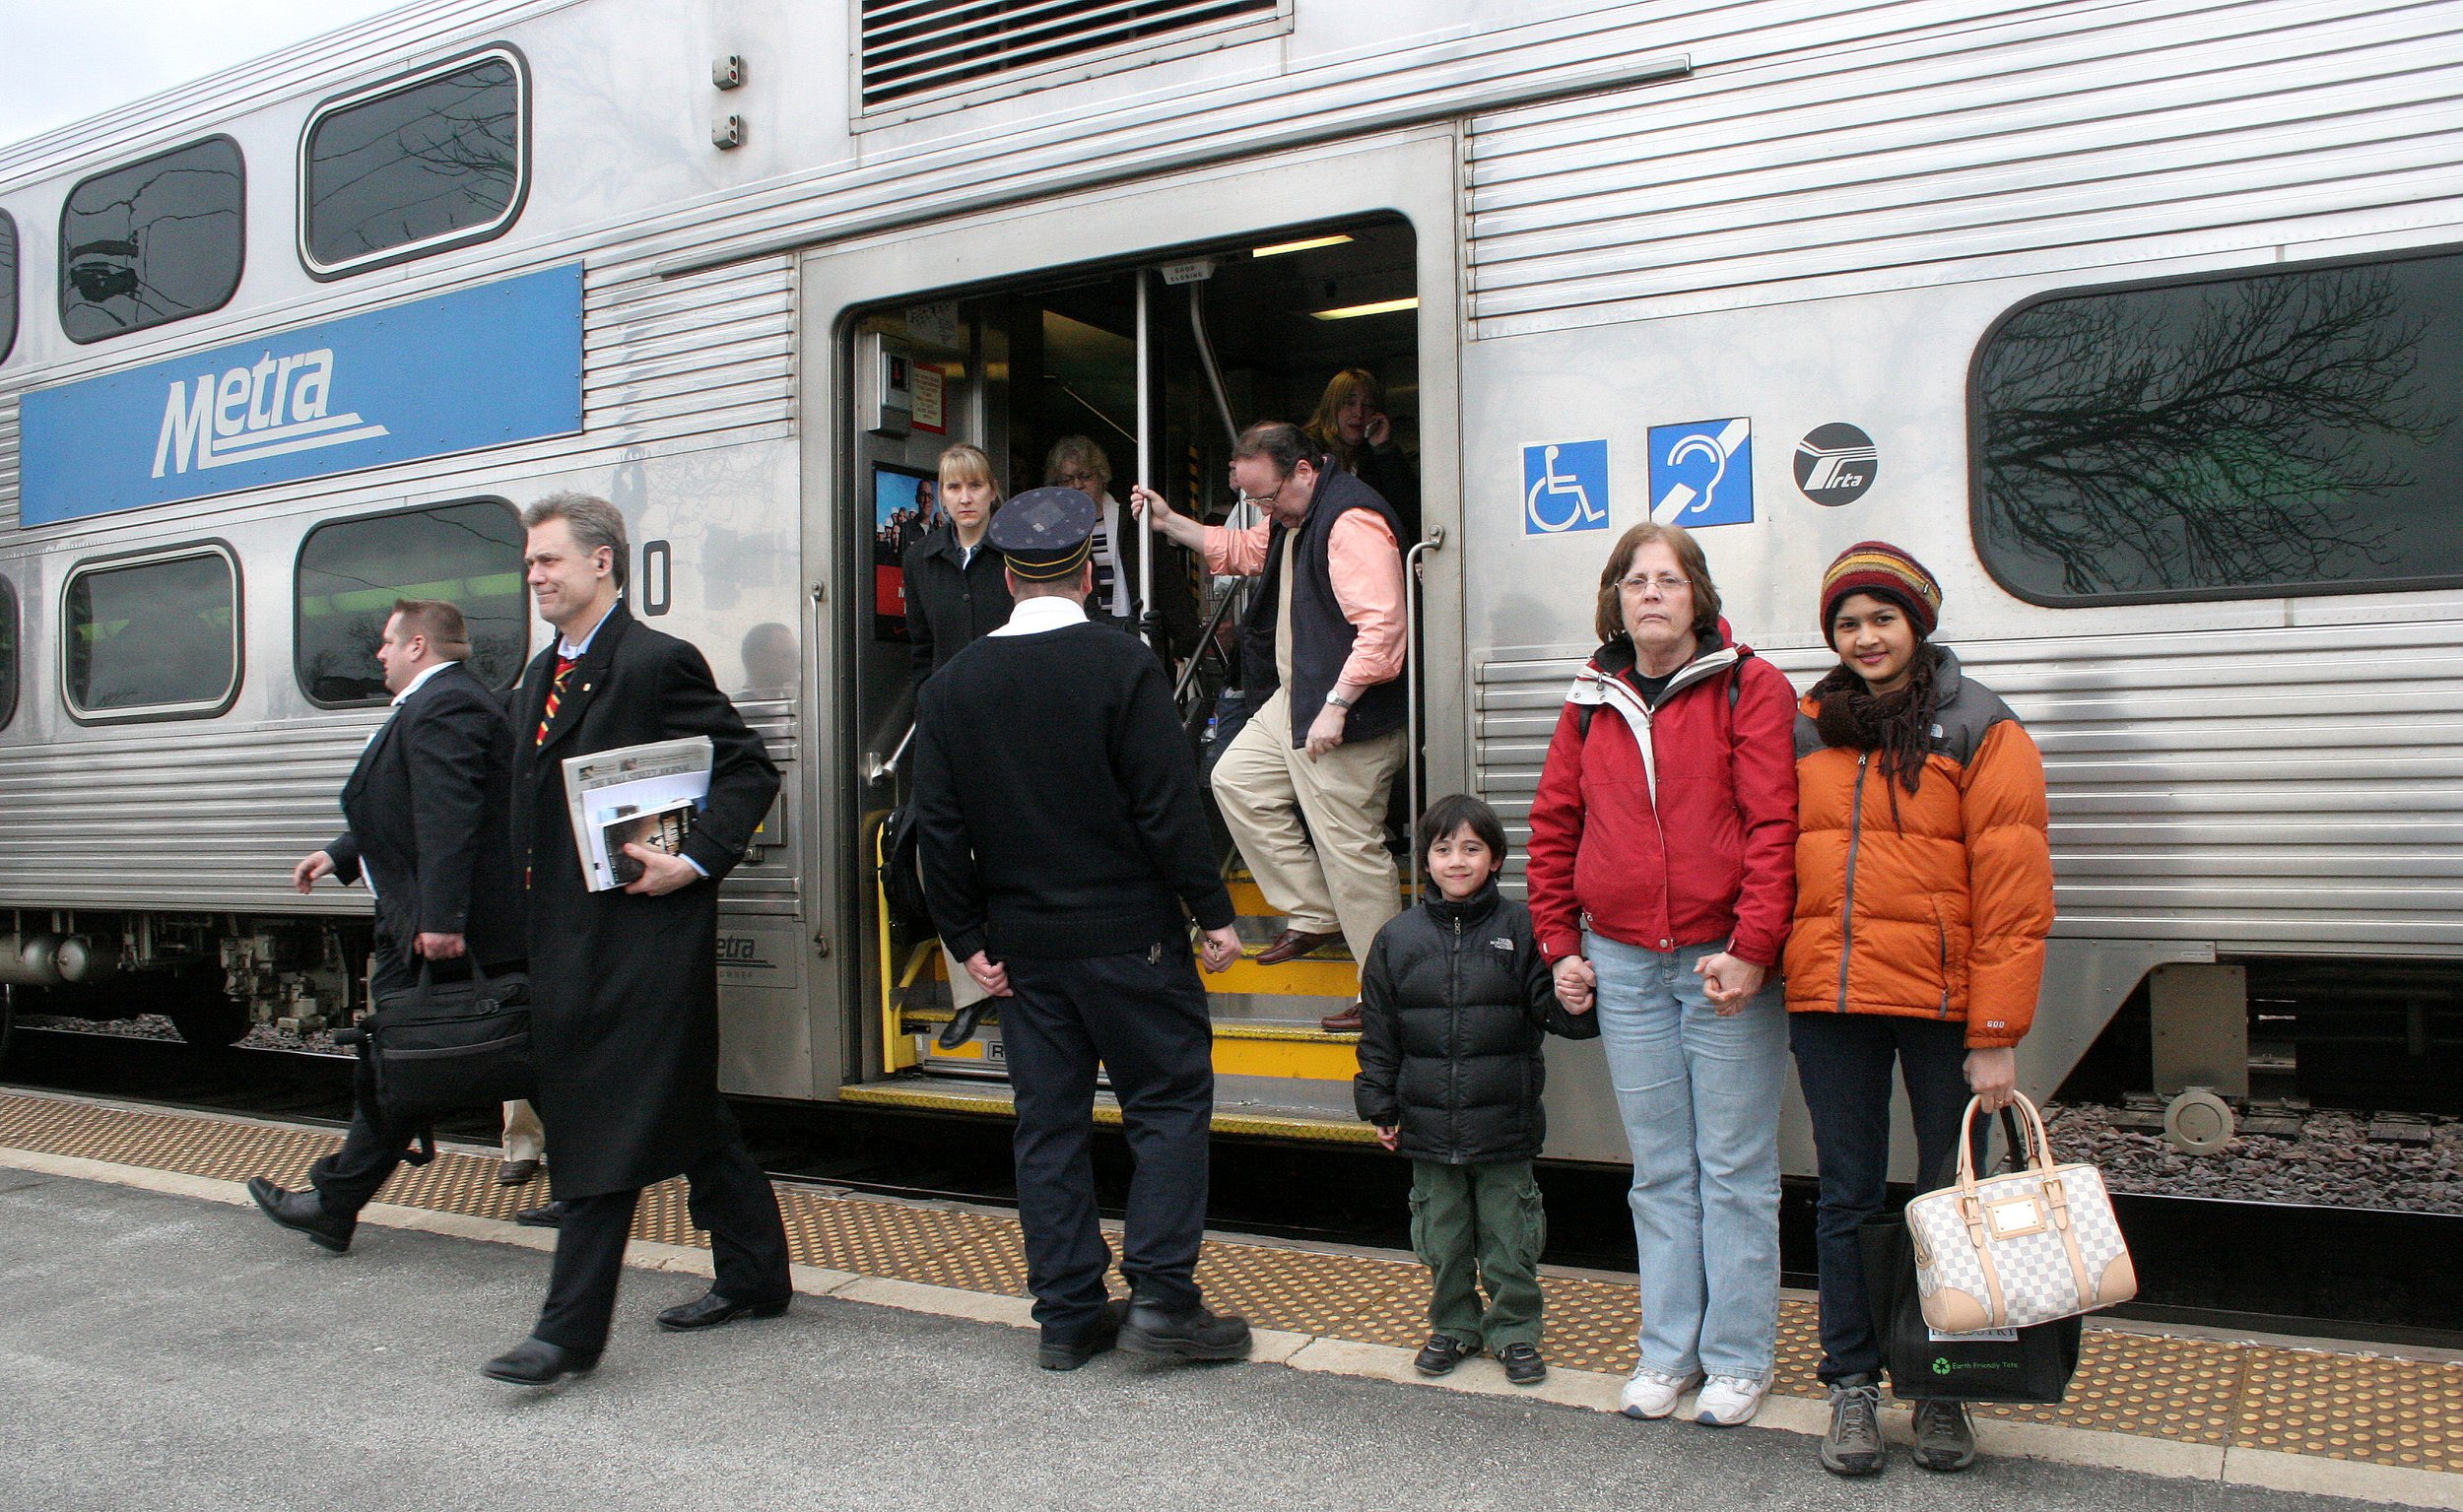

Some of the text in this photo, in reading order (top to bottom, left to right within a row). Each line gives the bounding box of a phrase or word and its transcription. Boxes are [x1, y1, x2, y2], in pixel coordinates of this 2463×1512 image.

[152, 348, 335, 479] Metra
[627, 540, 671, 617] 0
[716, 935, 755, 958] etra
[992, 1045, 1004, 1058] R
[1952, 1361, 1971, 1370] Earth
[1972, 1361, 2001, 1370] Friendly
